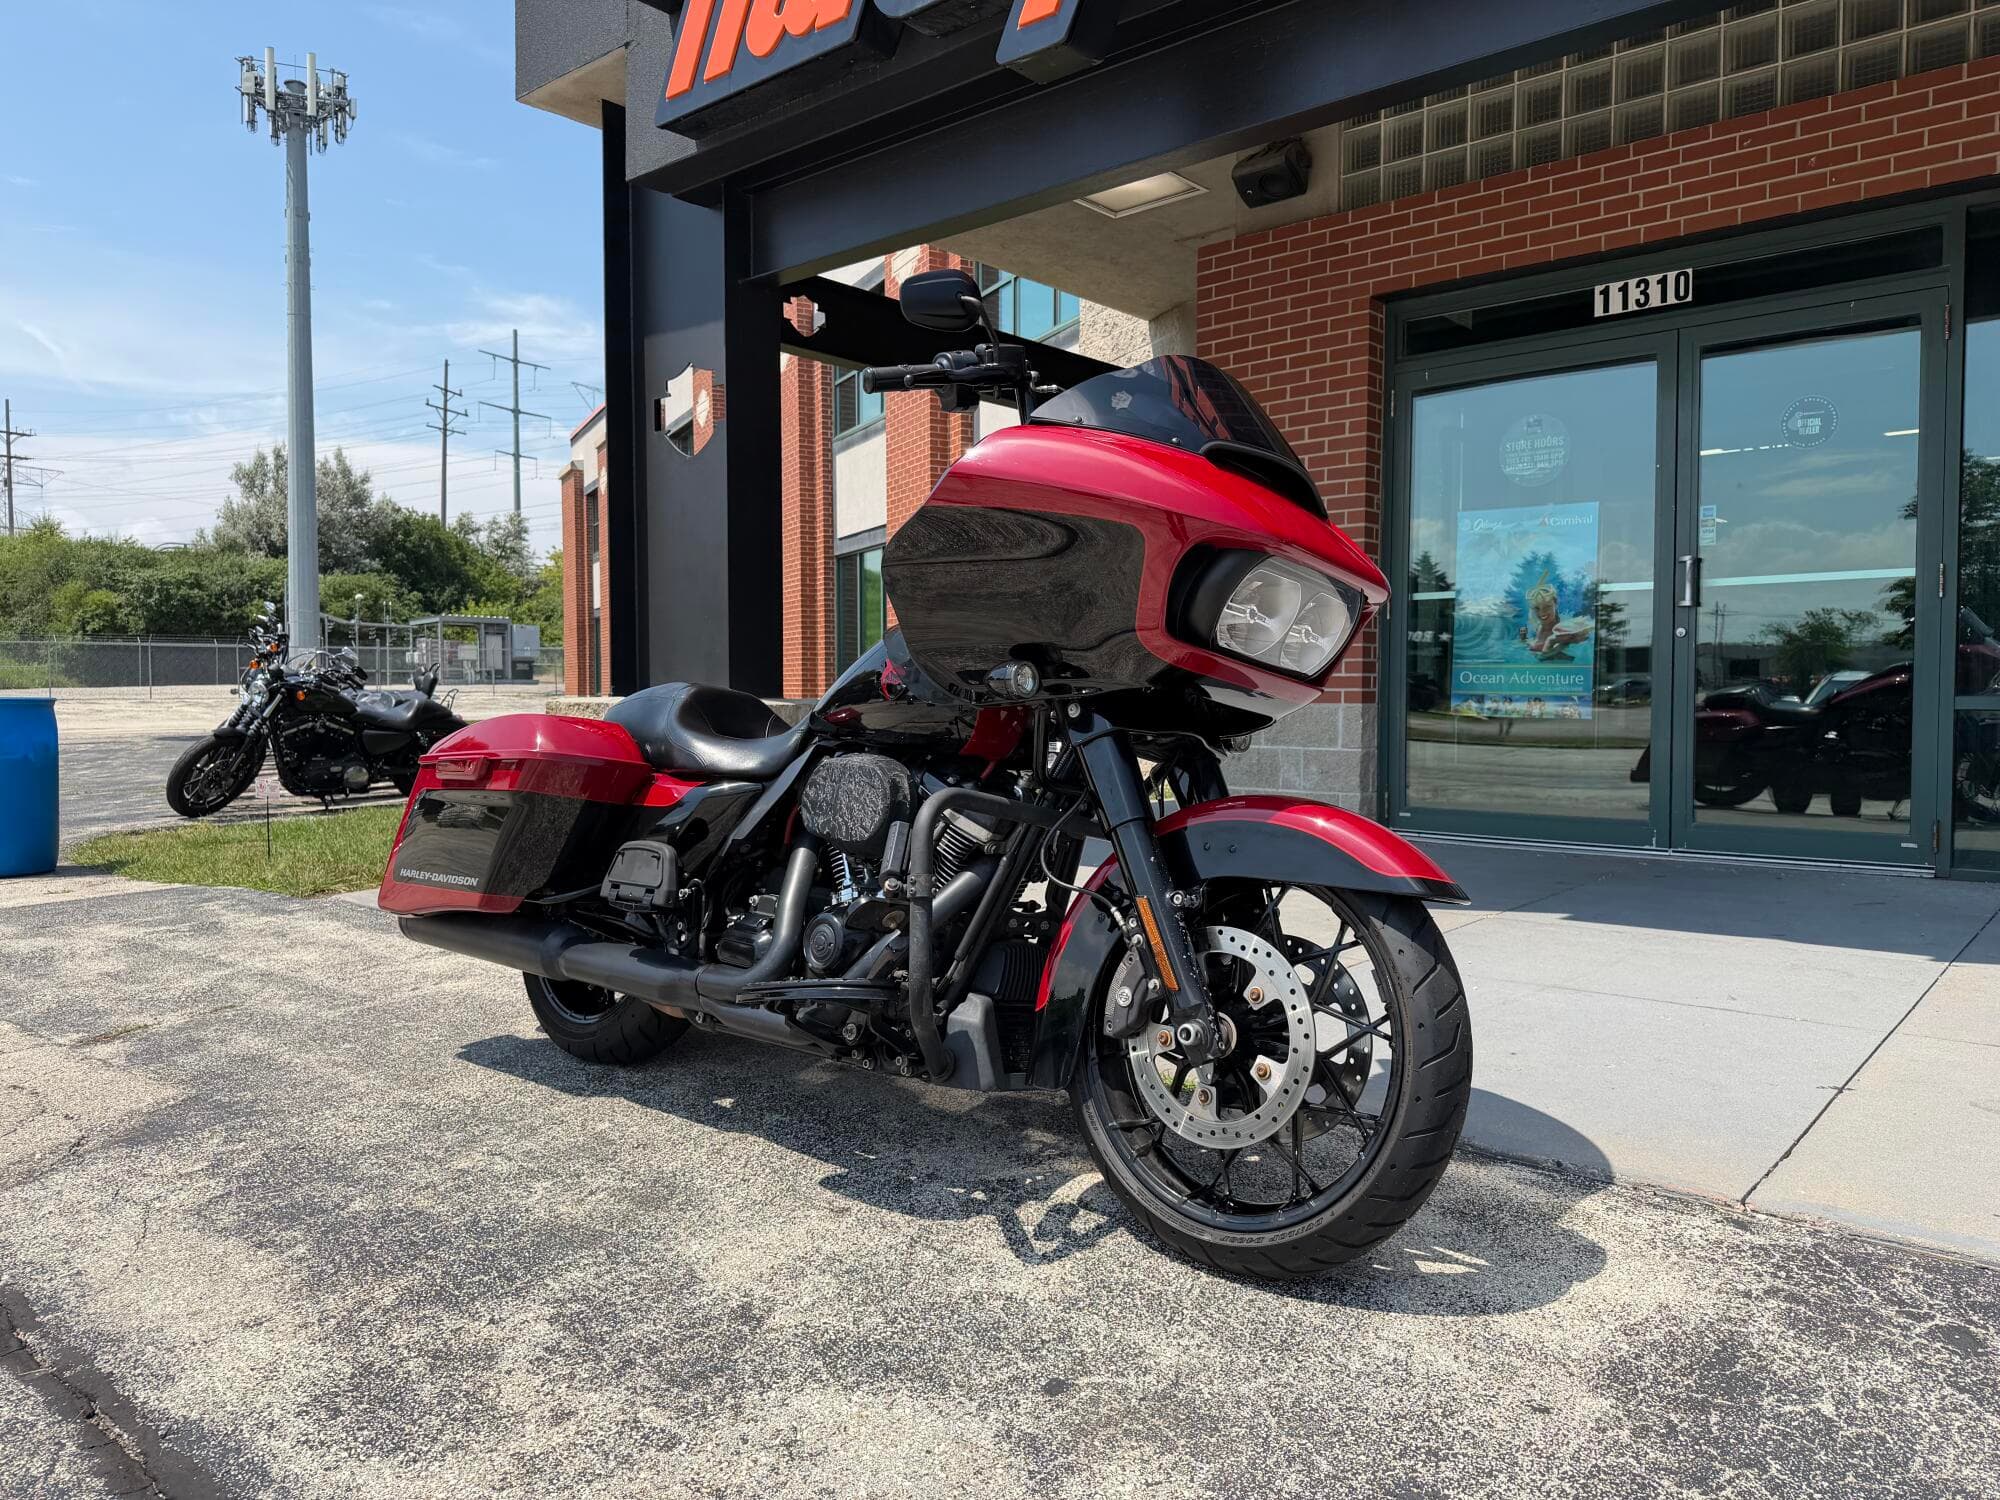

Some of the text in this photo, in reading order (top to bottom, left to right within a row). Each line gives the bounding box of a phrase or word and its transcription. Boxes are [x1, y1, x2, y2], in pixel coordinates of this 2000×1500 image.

[1599, 270, 1690, 314] 11310
[1797, 417, 1822, 428] OFFICIAL
[1504, 435, 1564, 452] STORE HOURS
[1550, 515, 1593, 527] Carnival
[1459, 670, 1584, 685] Ocean Adventure
[399, 867, 479, 886] HARLEY-DAVIDSON
